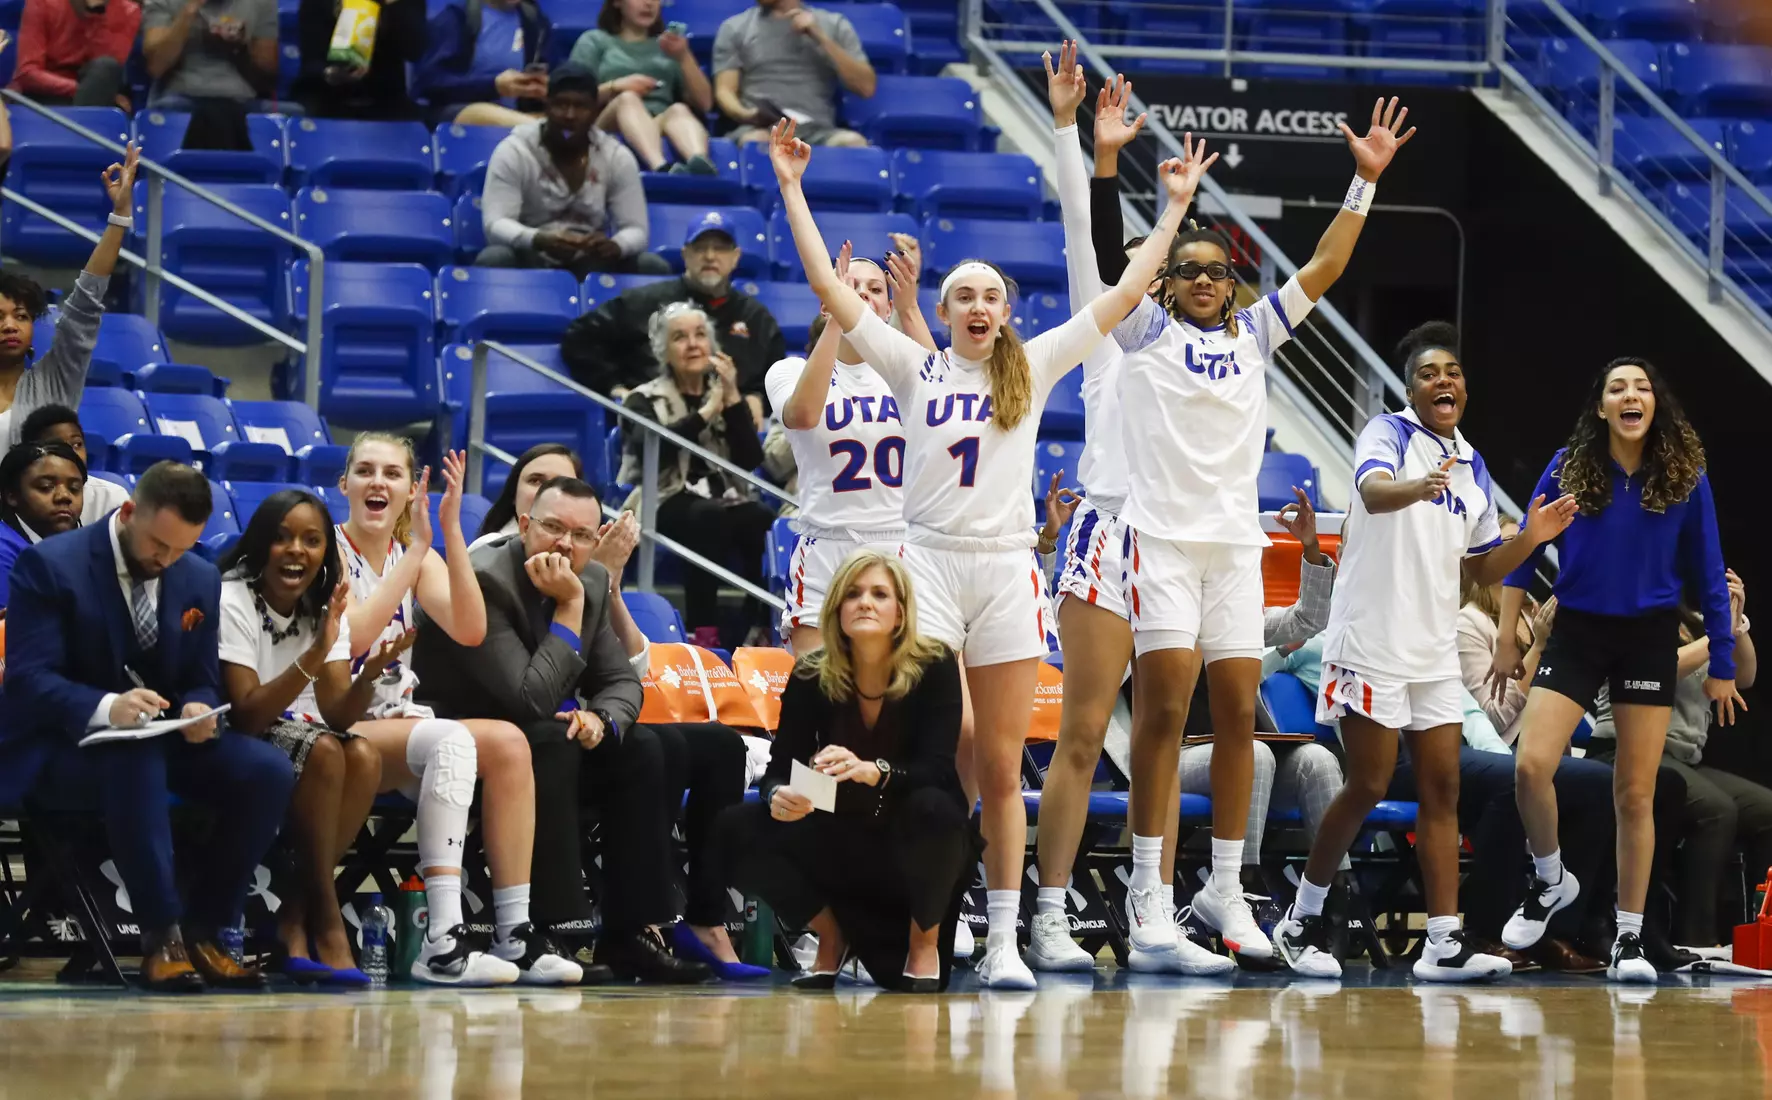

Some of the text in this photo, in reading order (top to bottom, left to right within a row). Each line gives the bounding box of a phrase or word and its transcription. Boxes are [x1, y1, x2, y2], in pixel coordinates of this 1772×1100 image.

[1255, 109, 1348, 135] ACCESS
[1184, 343, 1241, 380] UTA
[825, 394, 902, 431] UTA
[829, 436, 906, 493] 20
[947, 436, 980, 488] 1
[116, 924, 140, 934] UND
